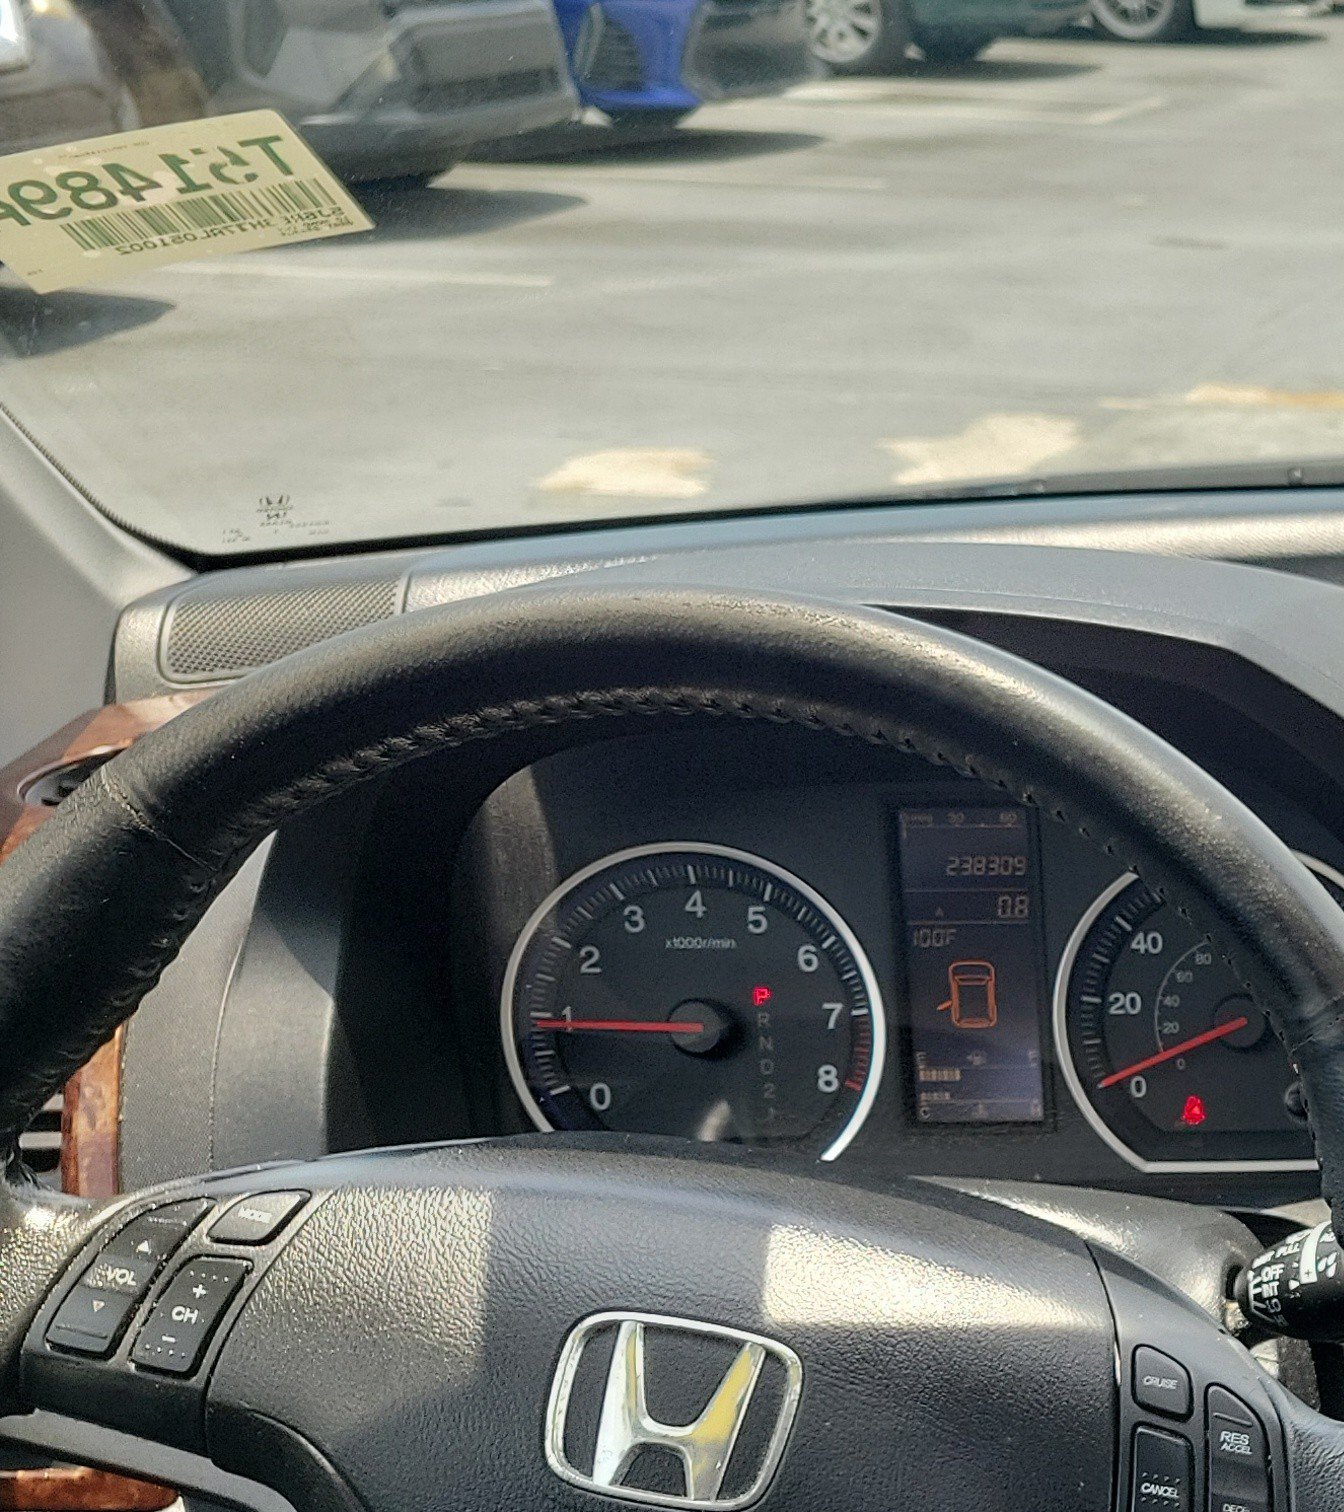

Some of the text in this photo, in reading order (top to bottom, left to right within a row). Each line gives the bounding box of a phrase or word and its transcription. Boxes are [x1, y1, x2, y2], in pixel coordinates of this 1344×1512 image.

[946, 856, 1027, 876] 238309
[685, 891, 706, 918] 4
[623, 905, 645, 933] 3
[747, 906, 768, 934] 5
[1131, 931, 1163, 954] 40
[579, 945, 602, 974] 2
[797, 945, 819, 972] 6
[753, 987, 771, 1005] P
[1109, 992, 1142, 1015] 20
[1163, 995, 1180, 1008] 40
[561, 1006, 574, 1031] 1
[822, 1003, 843, 1030] 7
[1163, 1022, 1180, 1034] 20
[1176, 1058, 1186, 1070] 0
[817, 1065, 839, 1092] 8
[1130, 1076, 1147, 1098] 0
[590, 1083, 611, 1111] 0
[107, 1265, 137, 1286] VOL
[1261, 1263, 1285, 1282] OFF
[171, 1305, 199, 1325] CH
[1142, 1375, 1178, 1389] CRUISE
[1220, 1431, 1249, 1446] RES
[1220, 1443, 1253, 1454] ACCEL
[1140, 1483, 1179, 1498] CANCEL
